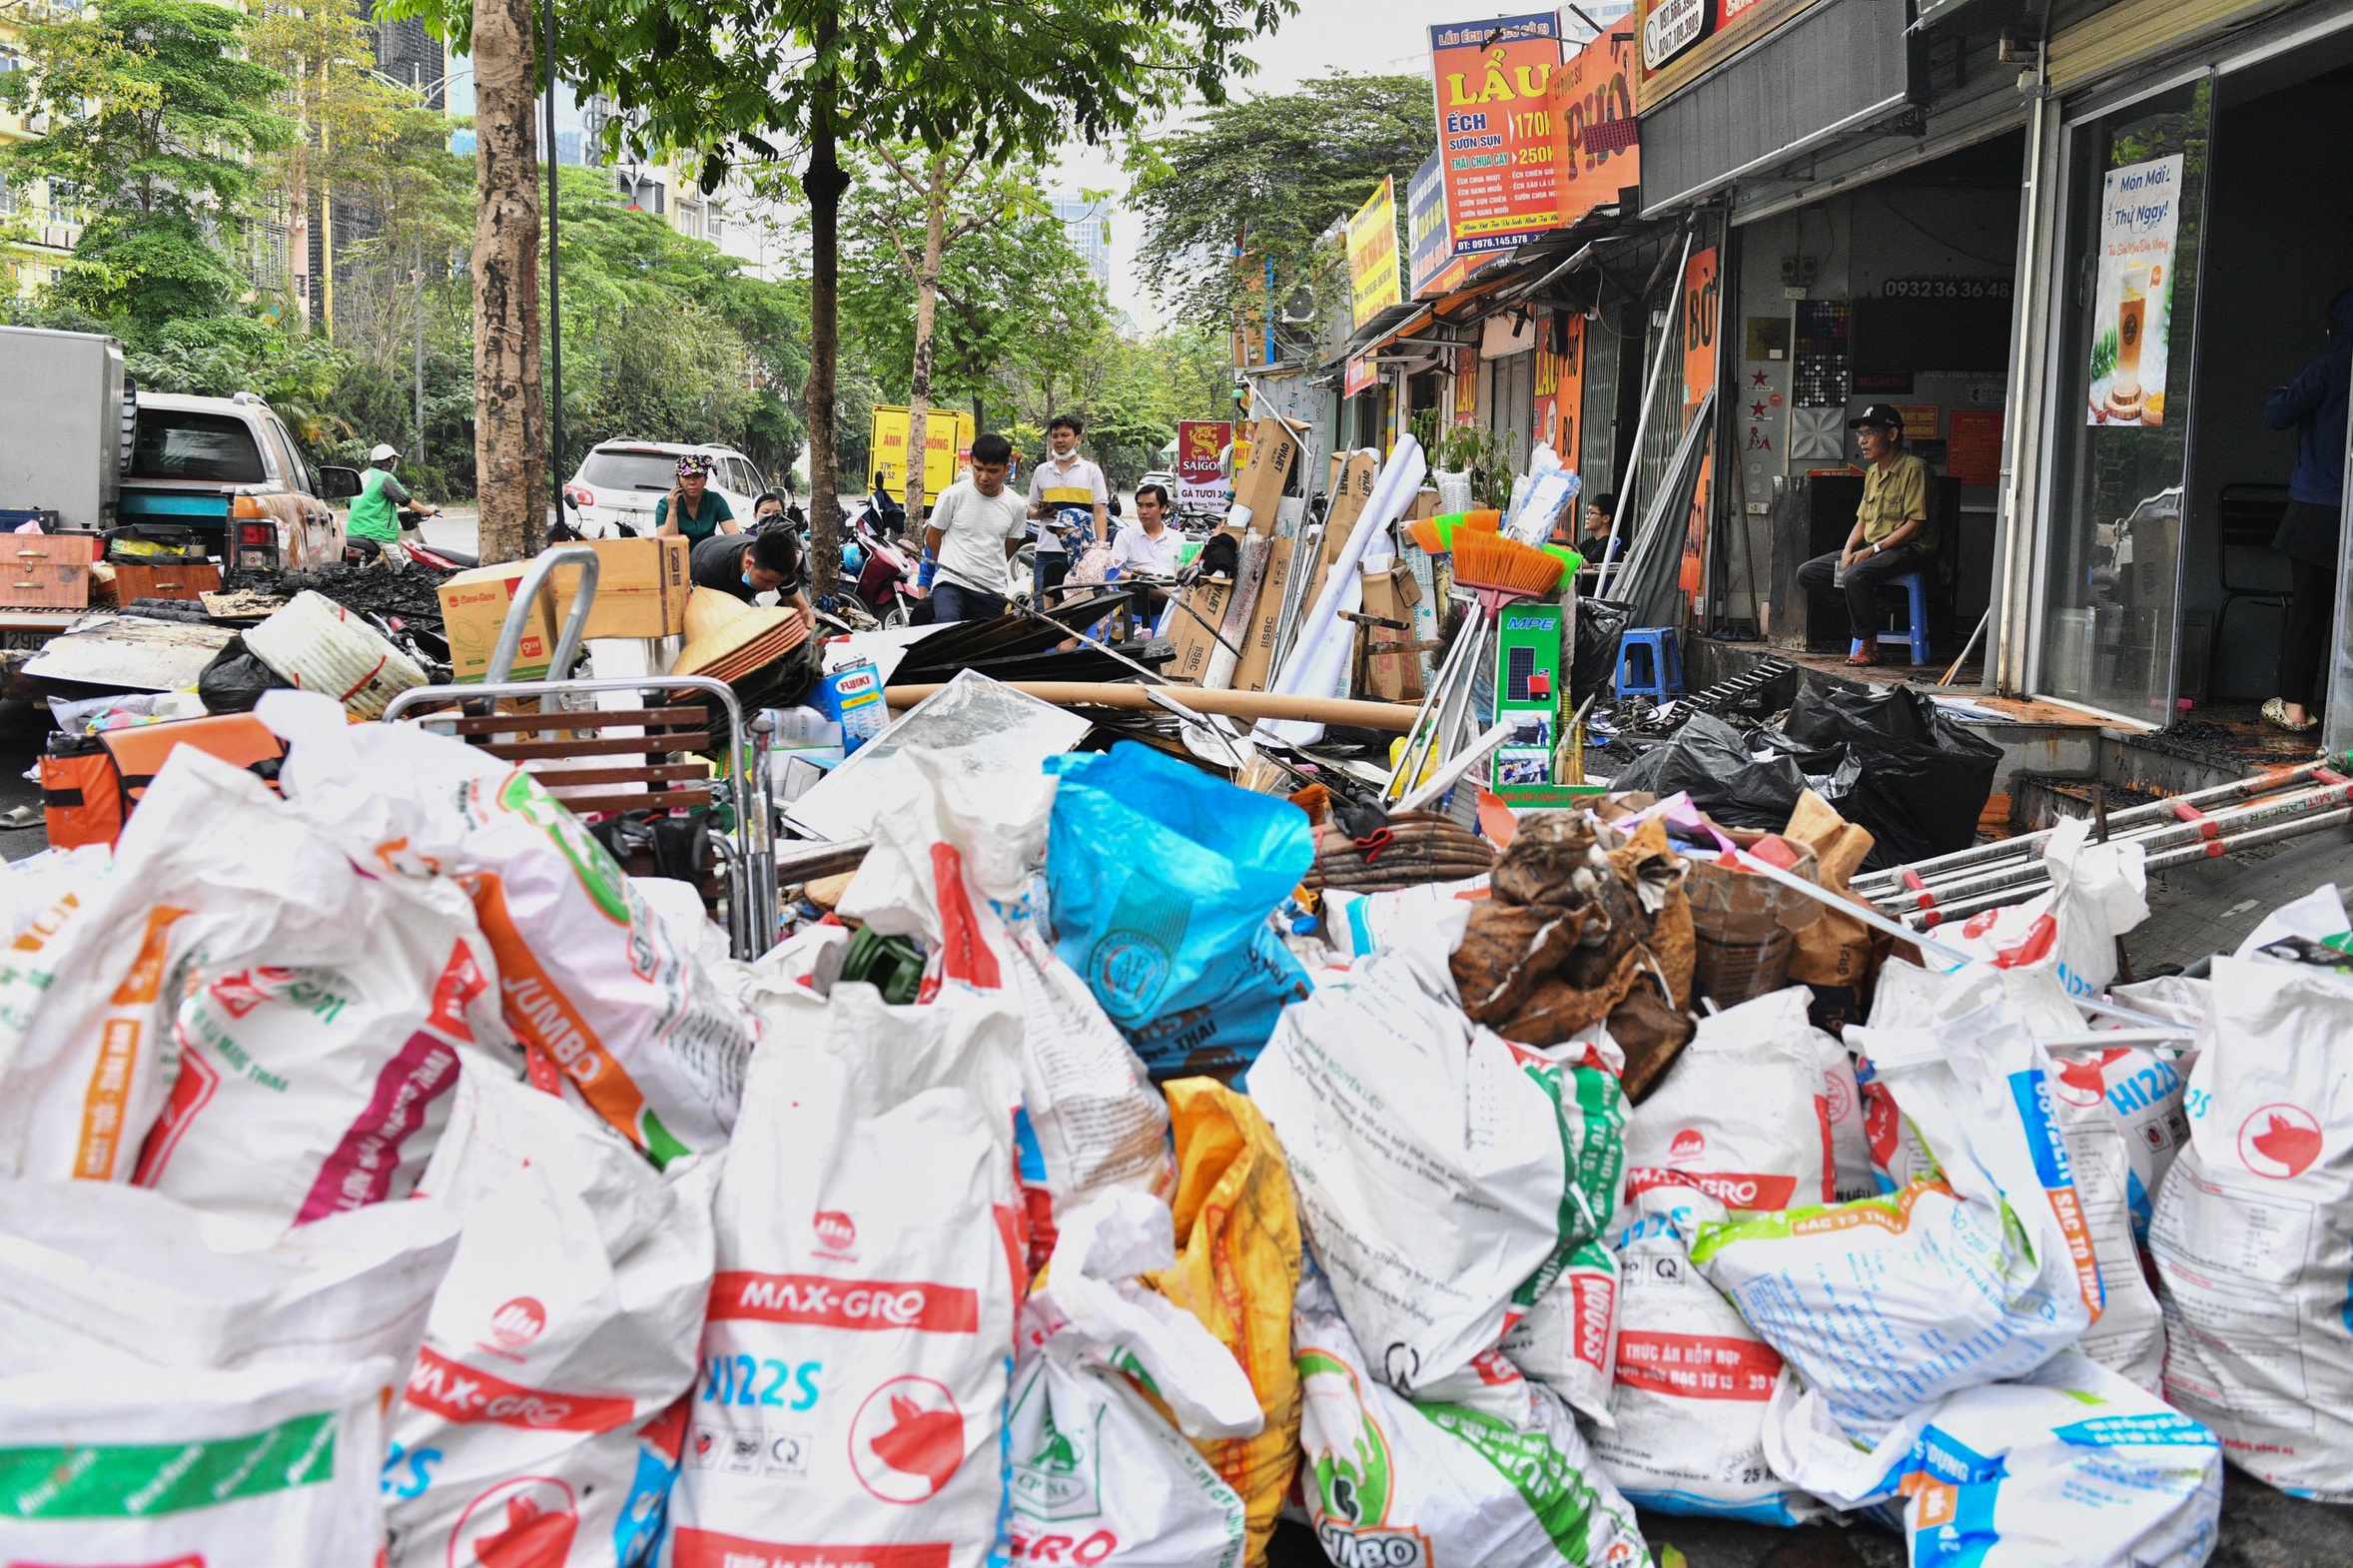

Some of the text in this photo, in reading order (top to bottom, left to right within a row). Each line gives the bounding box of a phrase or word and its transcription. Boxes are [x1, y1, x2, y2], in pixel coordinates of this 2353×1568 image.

[1446, 48, 1553, 106] LẨU
[1447, 110, 1487, 133] ẾCH
[1449, 135, 1501, 151] SƯỜN SỤN
[1450, 152, 1509, 171] THÁI CHUA CAY
[2120, 173, 2143, 192] Món
[2115, 200, 2168, 227] Thử Ngay!
[1885, 280, 1931, 298] 0932
[1181, 487, 1193, 498] GÀ
[1507, 617, 1556, 630] MPE
[502, 976, 601, 1083] JUMBO
[738, 1280, 925, 1324] MAX-GRO
